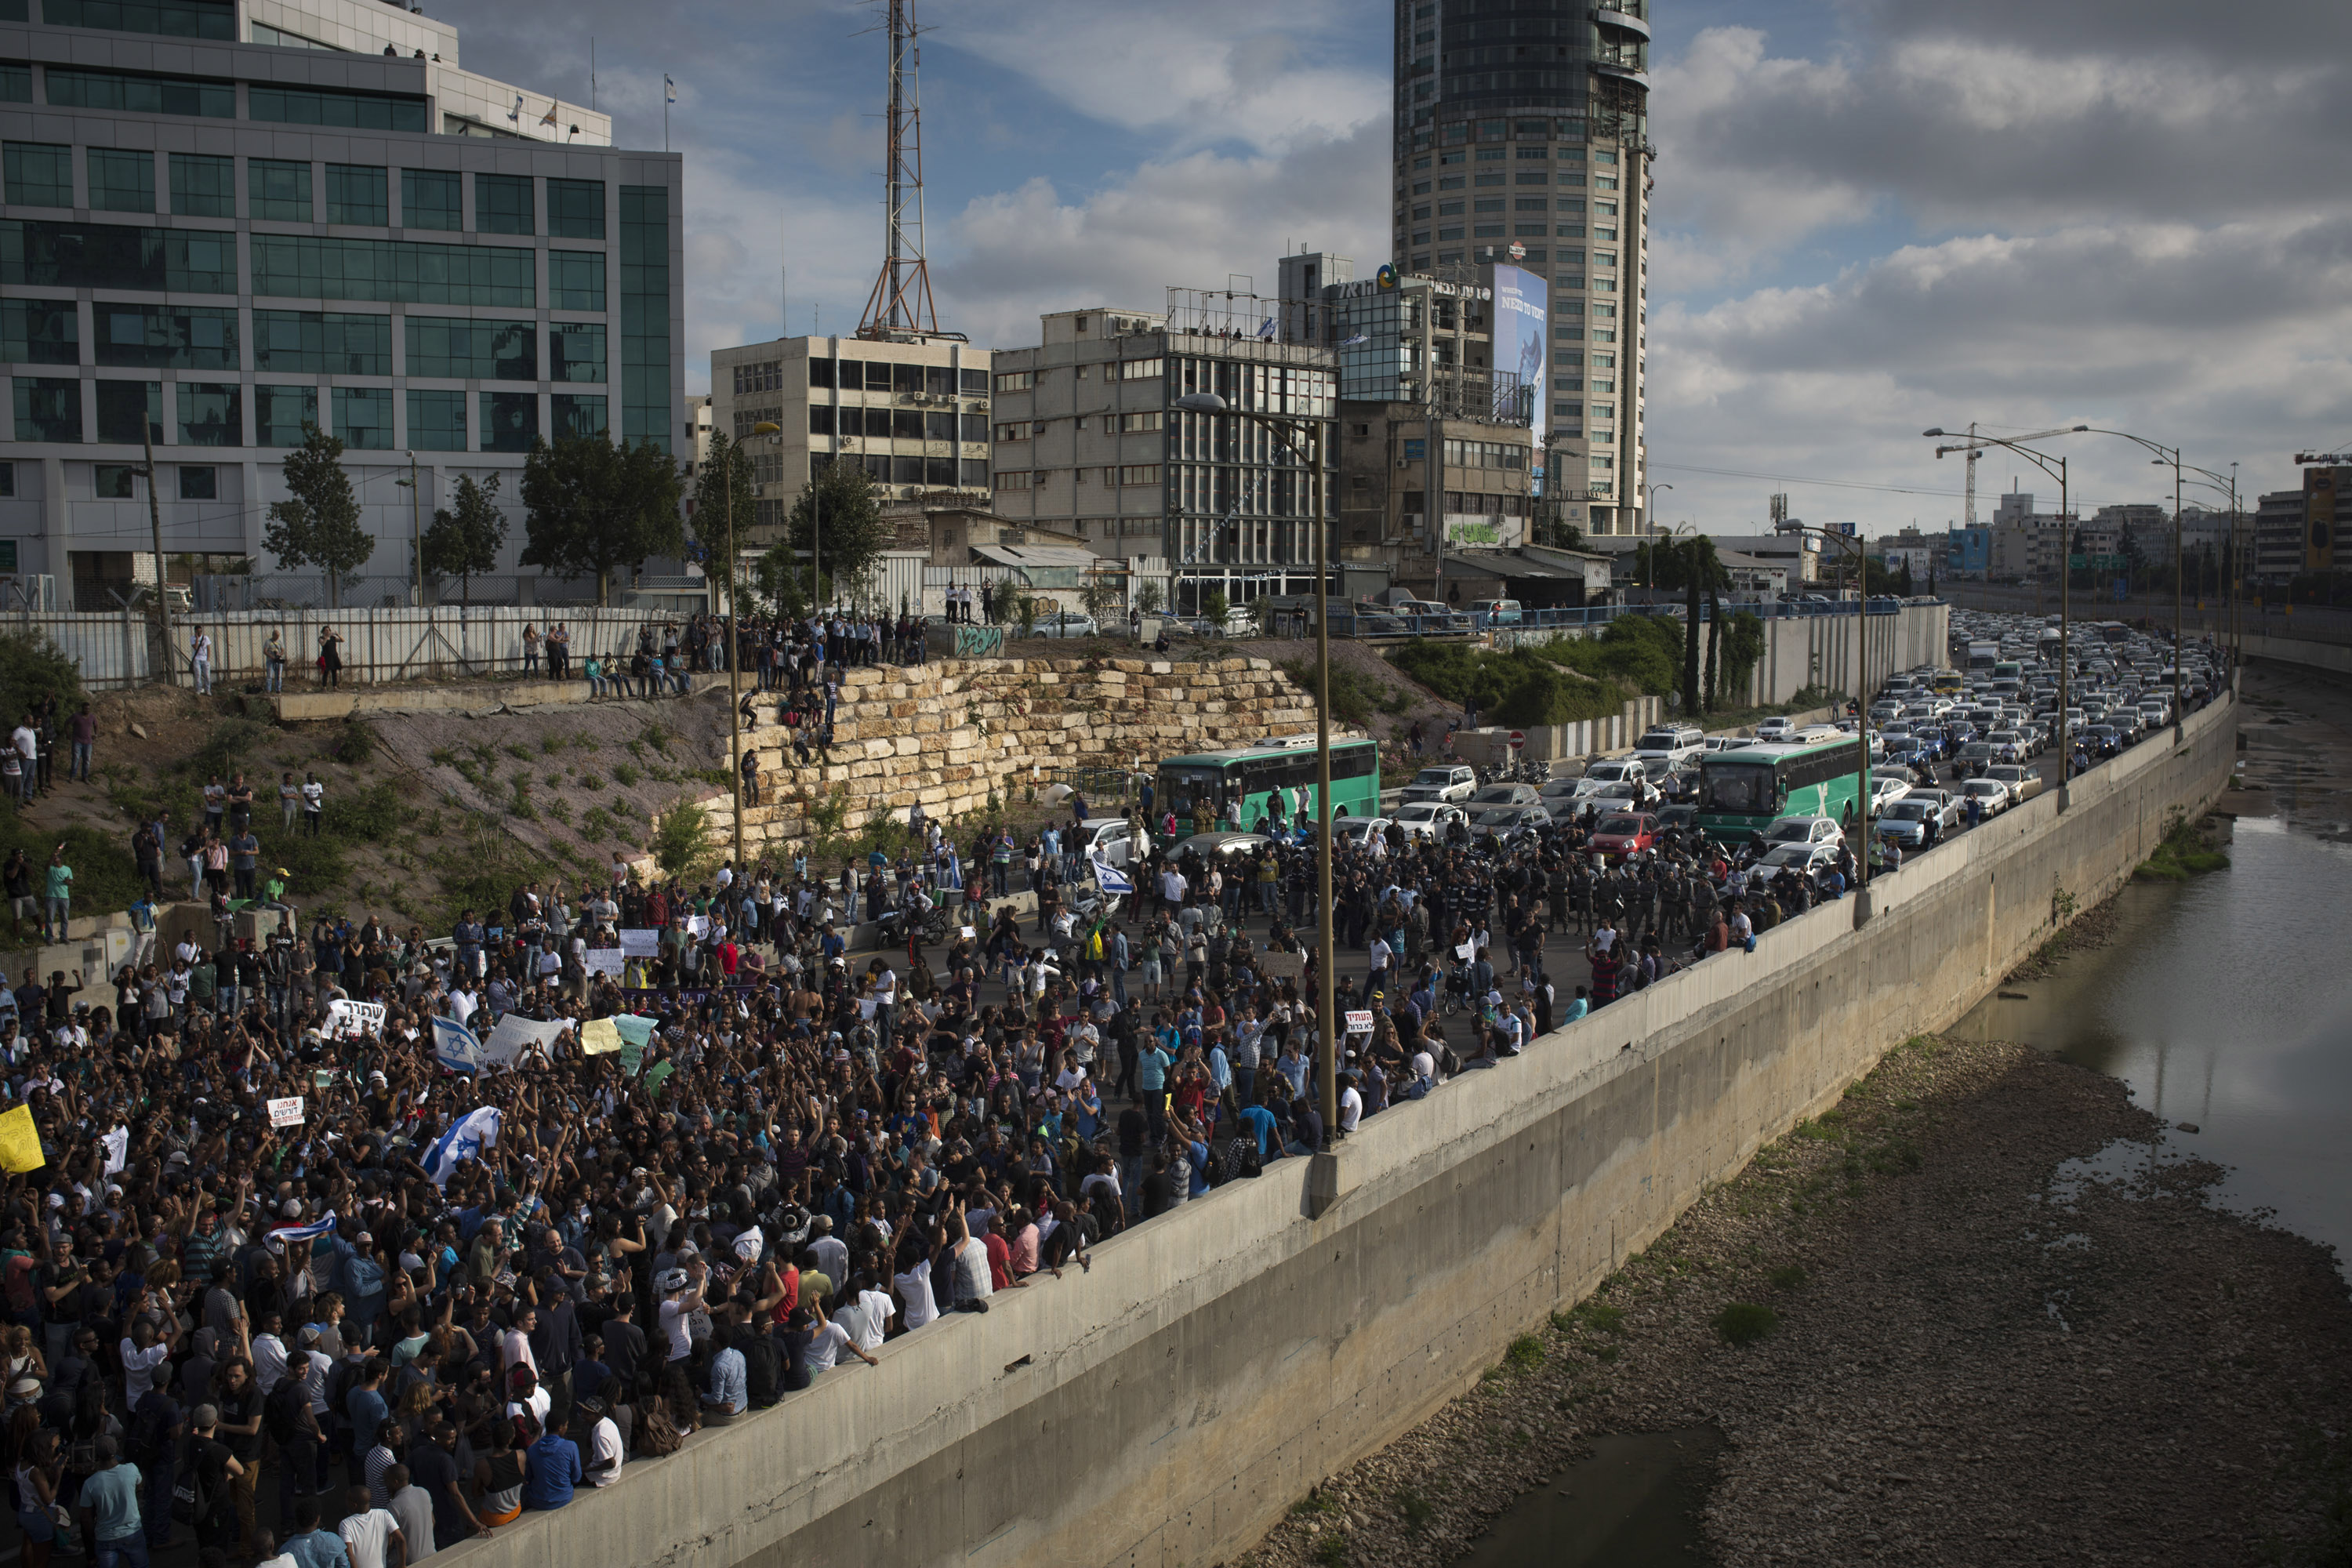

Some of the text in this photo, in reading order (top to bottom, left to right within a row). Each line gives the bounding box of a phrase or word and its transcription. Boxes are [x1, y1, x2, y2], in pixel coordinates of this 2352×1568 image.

[1338, 278, 1377, 299] הראל
[1501, 296, 1544, 321] NEED TO VENT
[1346, 1012, 1372, 1022] העתיד
[277, 1098, 297, 1109] אנחנו
[274, 1106, 298, 1117] דורשים
[670, 1276, 684, 1288] NEW
[173, 1484, 195, 1504] VANS
